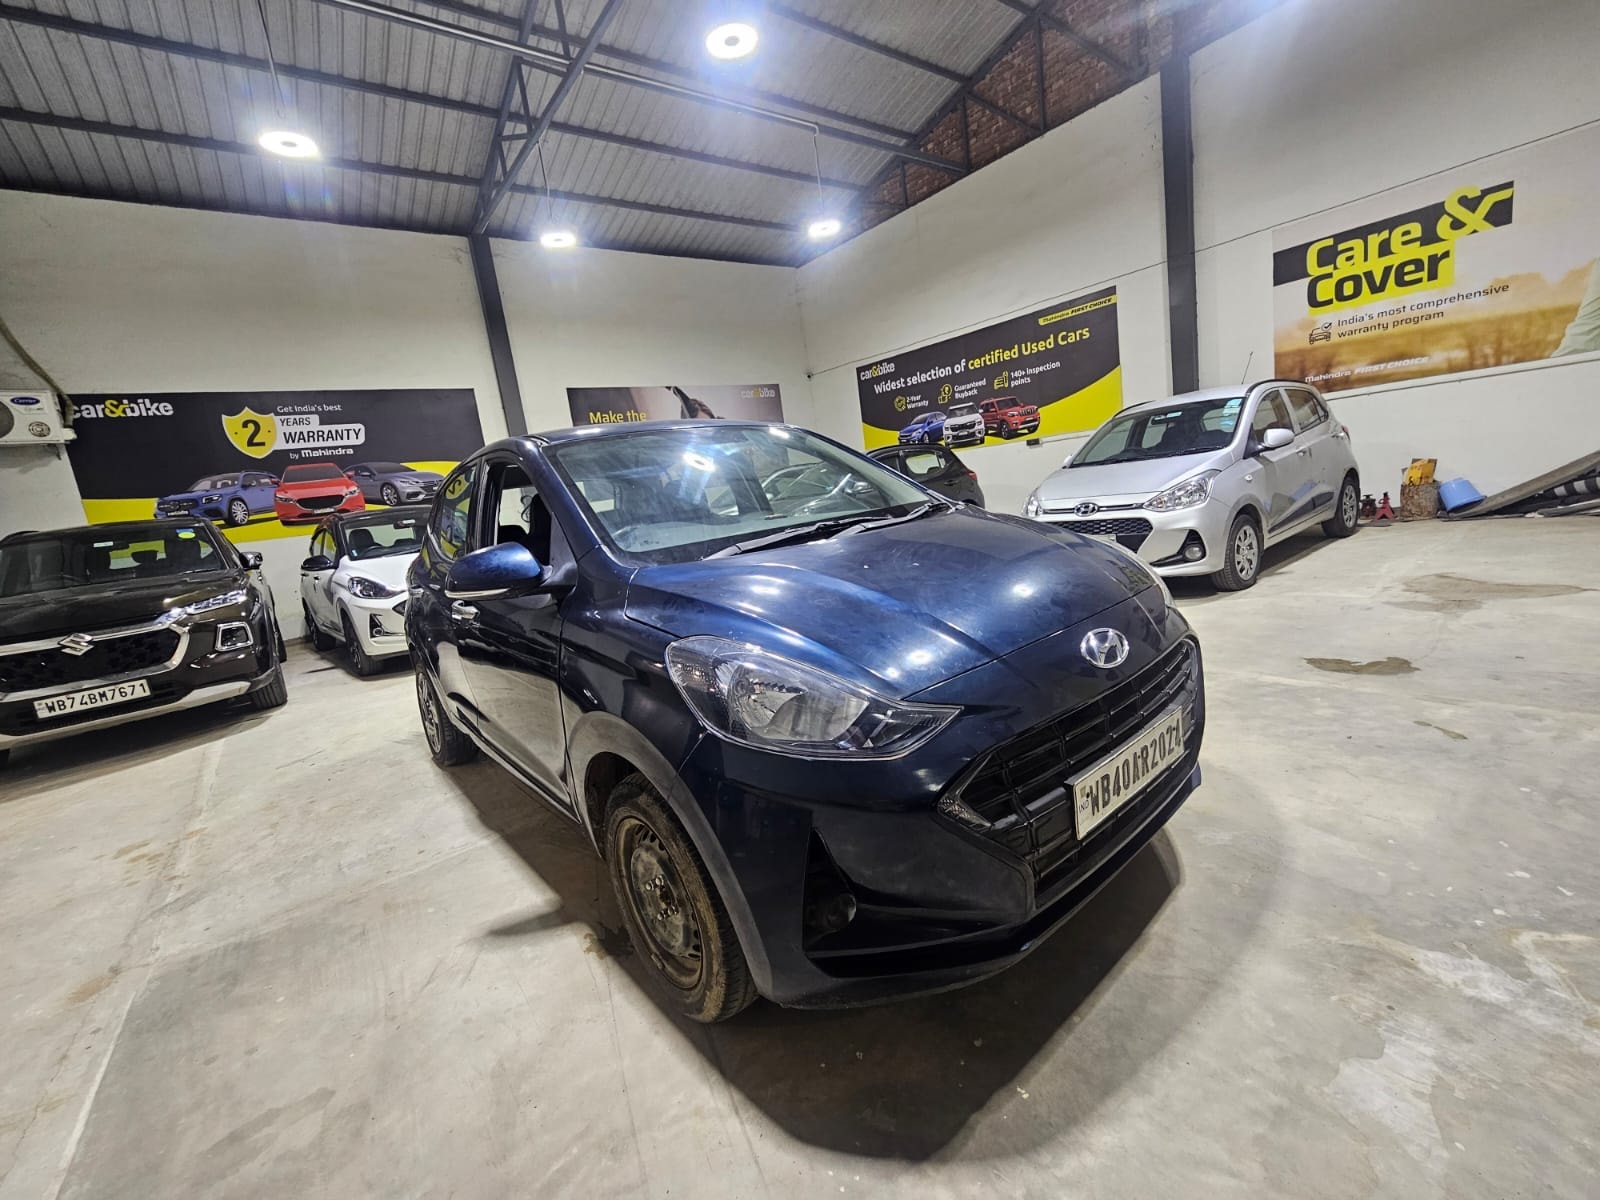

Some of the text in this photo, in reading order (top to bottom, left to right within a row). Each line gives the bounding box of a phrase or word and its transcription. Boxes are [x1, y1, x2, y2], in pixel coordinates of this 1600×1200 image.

[1306, 185, 1514, 277] Care &
[1307, 250, 1450, 308] Cover
[1070, 305, 1088, 314] FIRST
[1089, 298, 1112, 309] CHOICE
[1337, 284, 1510, 327] India's most comprehensive
[1337, 311, 1445, 339] warranty program
[873, 327, 1090, 395] Widest selection of certified Used Cars
[1010, 361, 1061, 379] 140+ Inspection
[1304, 356, 1430, 383] Mahindra FIRST CHOICE
[860, 362, 895, 380] car&bike
[954, 378, 986, 392] Guaranteed
[1010, 377, 1031, 388] points
[955, 388, 978, 400] Buyback
[72, 398, 174, 418] car&bike
[276, 403, 343, 413] Get India's best
[906, 400, 929, 409] Warranty
[279, 417, 311, 427] YEARS
[589, 409, 647, 424] Make the
[241, 419, 266, 447] 2
[283, 428, 362, 444] WARRANTY
[289, 448, 354, 460] by Mahindra
[45, 683, 146, 713] WB74BM7671
[1088, 717, 1182, 816] WB40AR2024
